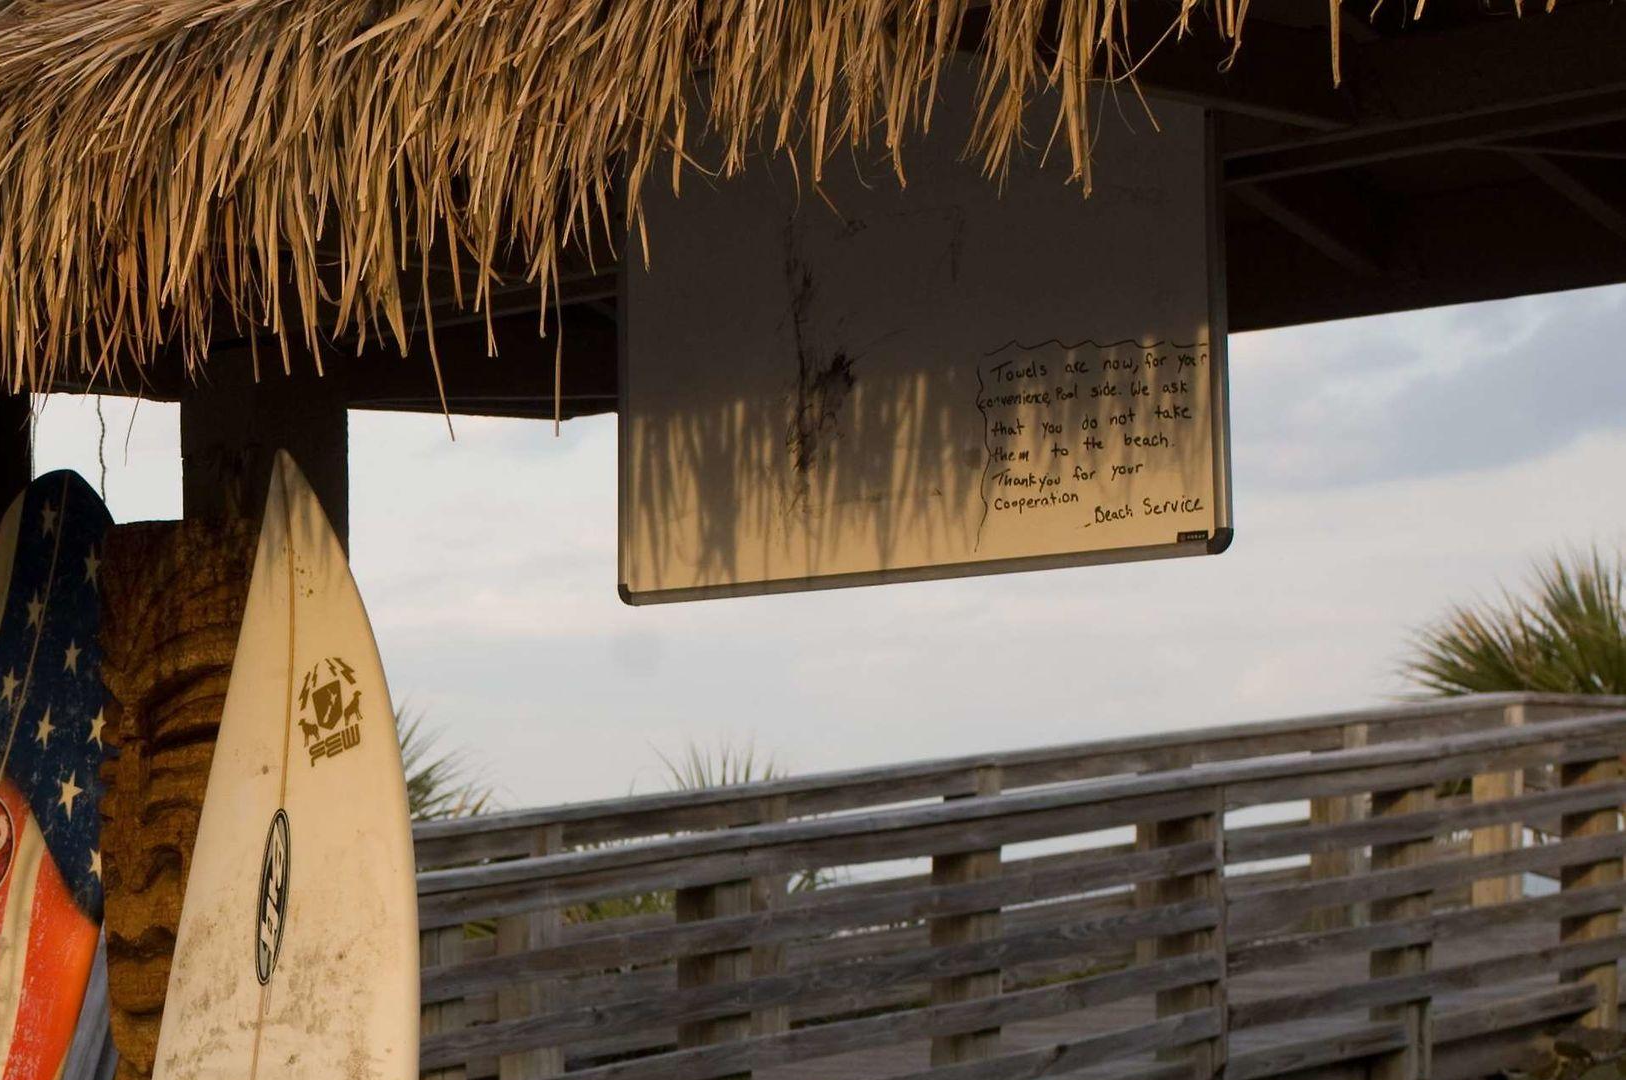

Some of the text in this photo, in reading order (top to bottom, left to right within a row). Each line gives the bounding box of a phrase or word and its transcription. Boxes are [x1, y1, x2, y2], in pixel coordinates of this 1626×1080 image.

[990, 360, 1048, 383] Towels
[1065, 360, 1090, 375] are
[1103, 357, 1139, 374] now,
[1144, 352, 1167, 369] for
[1055, 382, 1078, 401] Pool
[1130, 380, 1150, 397] We
[1162, 379, 1189, 394] ask
[991, 404, 1193, 440] that you do not take
[991, 446, 1030, 462] them
[1050, 442, 1070, 458] to
[1083, 435, 1104, 451] the
[1073, 465, 1096, 481] for
[1111, 463, 1144, 482] your
[1142, 495, 1204, 517] Service
